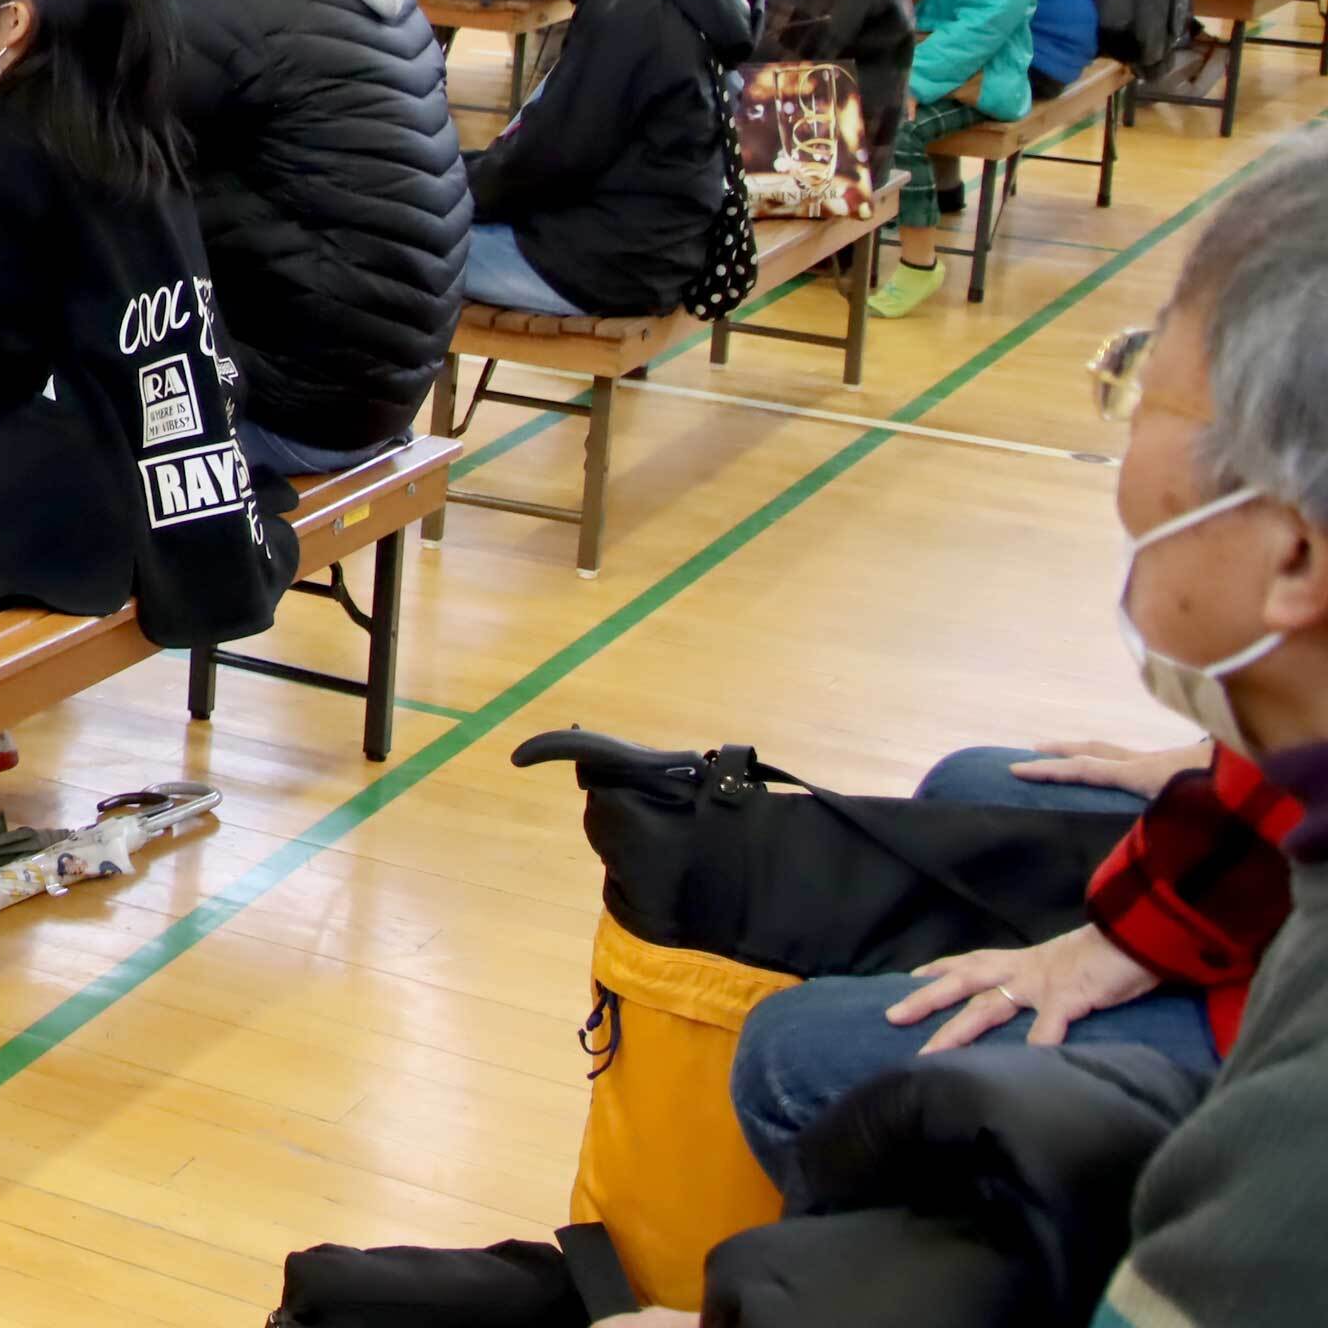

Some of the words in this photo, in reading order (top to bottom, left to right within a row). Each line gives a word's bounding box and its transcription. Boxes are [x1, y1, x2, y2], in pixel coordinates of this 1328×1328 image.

[119, 280, 191, 355] COOL
[143, 366, 186, 404] RA
[177, 401, 186, 414] IS
